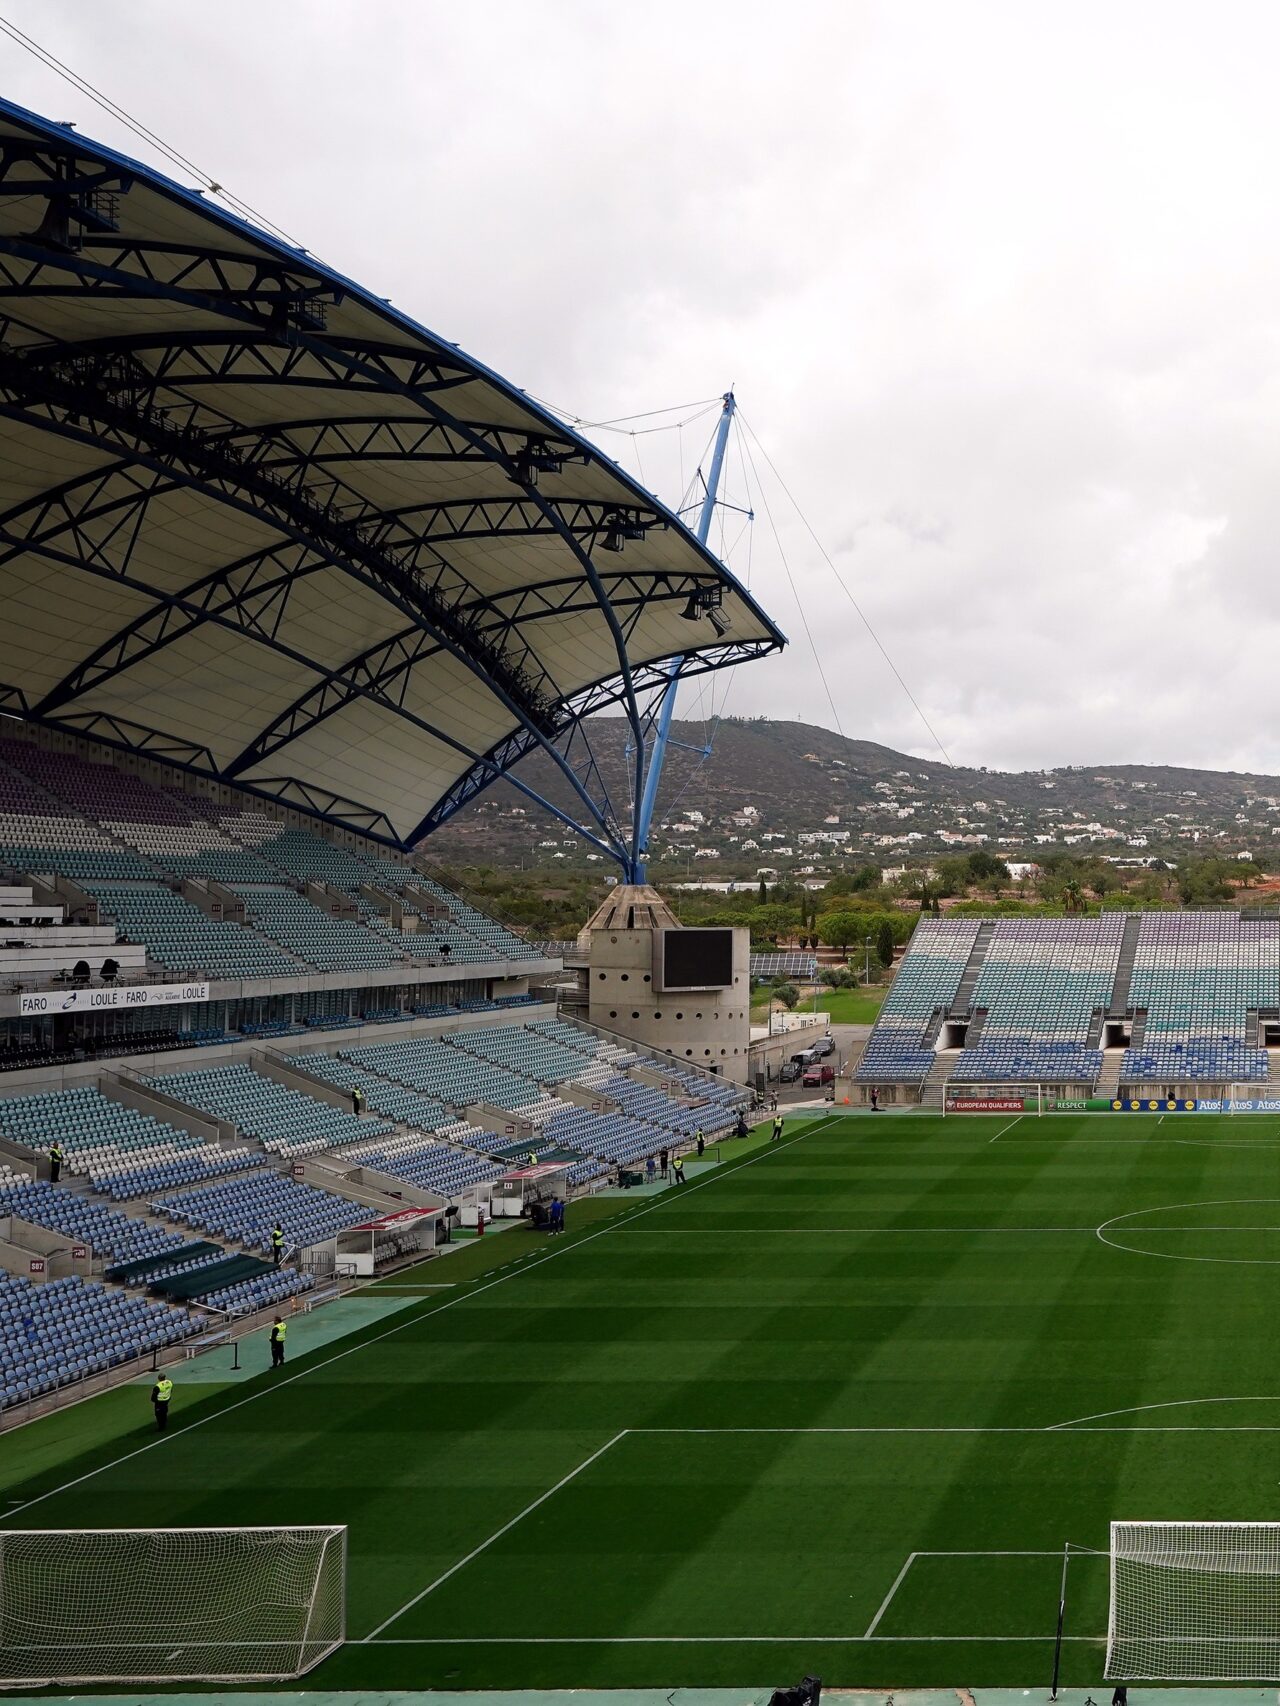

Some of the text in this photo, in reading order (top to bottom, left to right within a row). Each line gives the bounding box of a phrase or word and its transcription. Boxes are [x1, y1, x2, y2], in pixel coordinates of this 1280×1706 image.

[22, 998, 47, 1011] FARO
[90, 989, 118, 1006] LOULÉ
[126, 991, 148, 1003] FARO
[182, 984, 205, 999] LOULÉ
[988, 1102, 1022, 1110] QUALIFIERS
